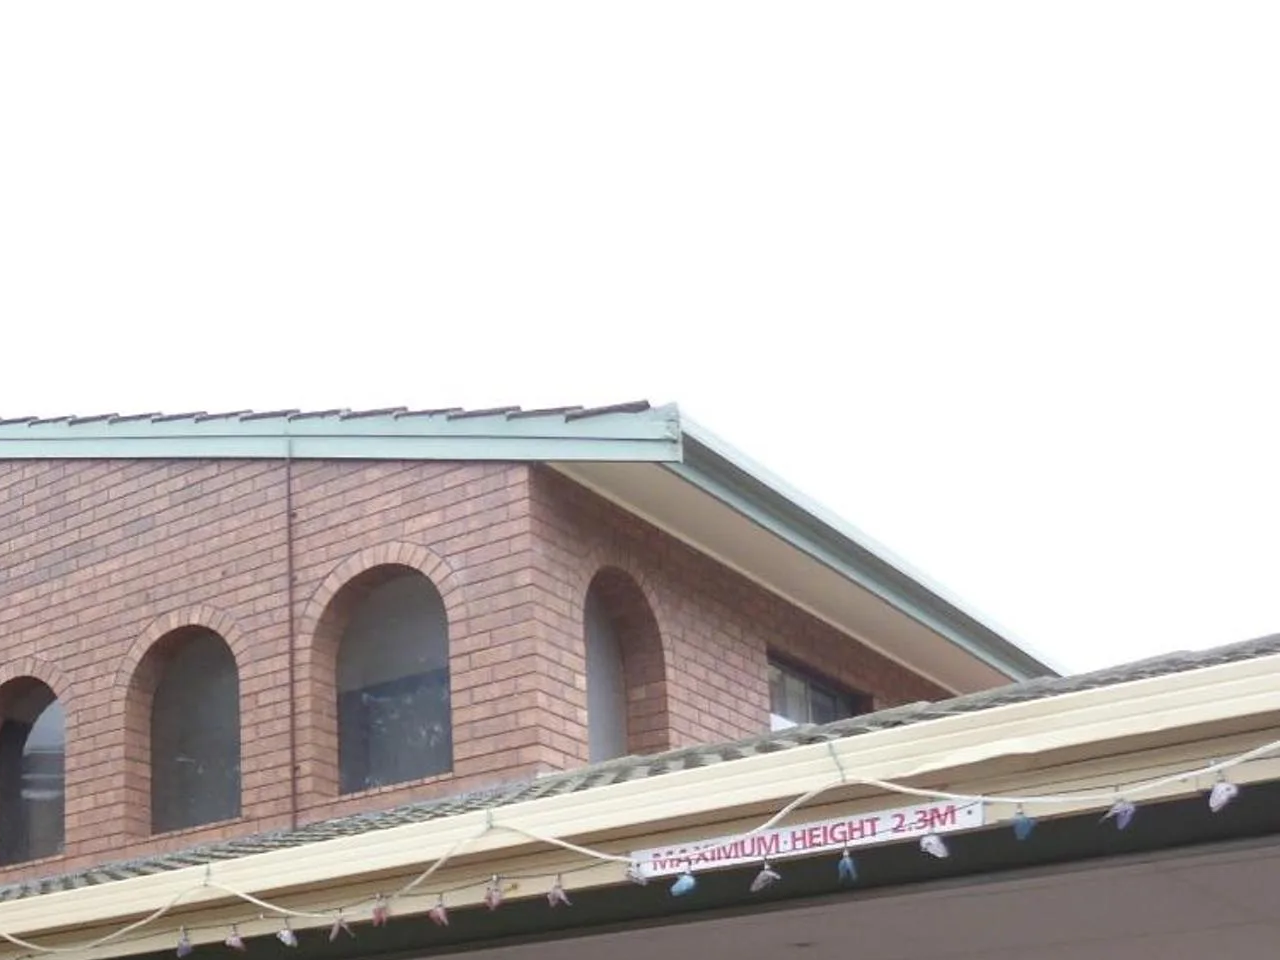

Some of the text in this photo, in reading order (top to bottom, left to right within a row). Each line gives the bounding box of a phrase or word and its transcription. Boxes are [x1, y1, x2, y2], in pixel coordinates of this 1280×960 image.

[653, 806, 956, 870] MAXIMUM HEIGHT 2.3M
